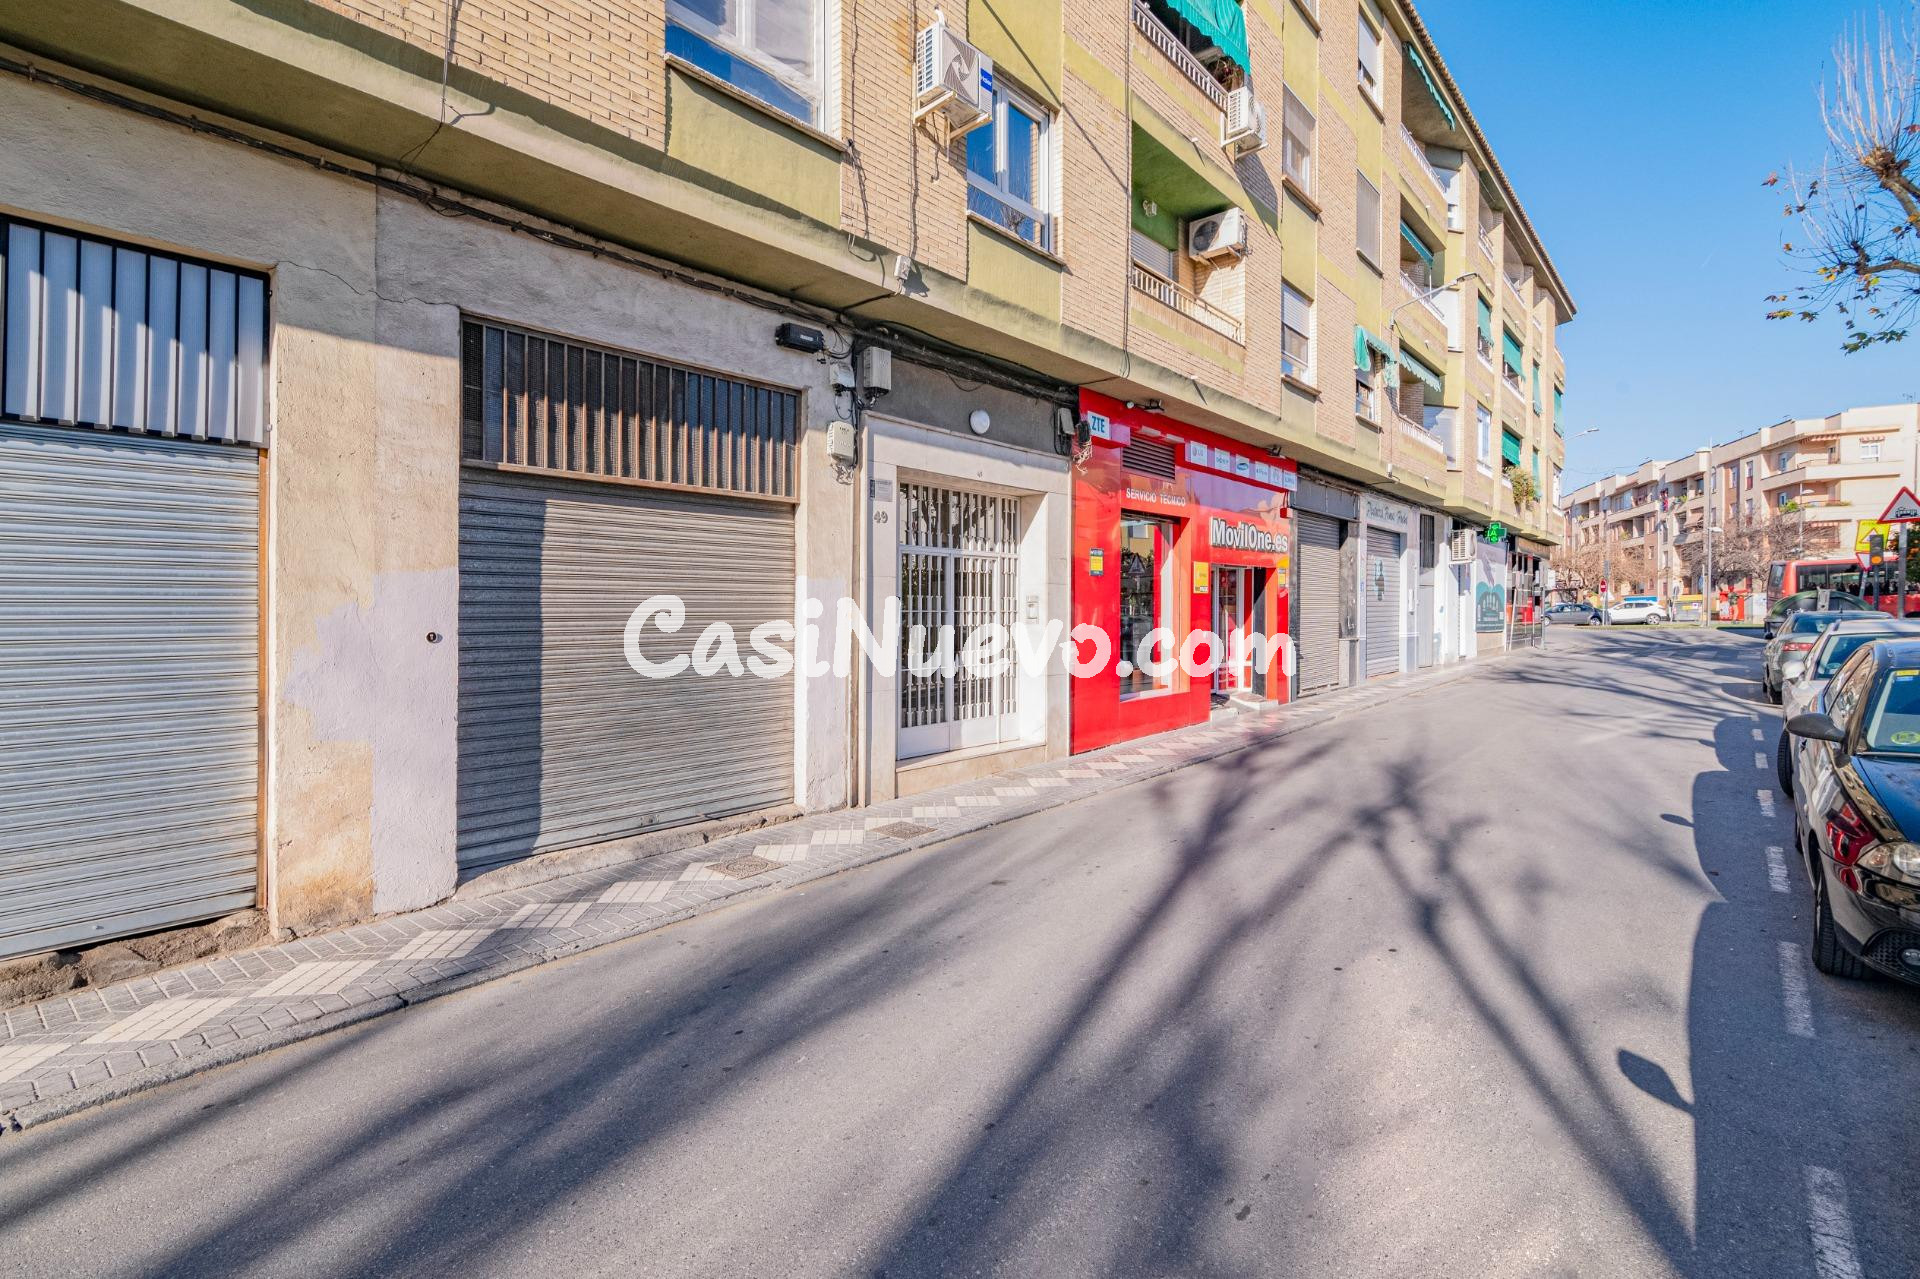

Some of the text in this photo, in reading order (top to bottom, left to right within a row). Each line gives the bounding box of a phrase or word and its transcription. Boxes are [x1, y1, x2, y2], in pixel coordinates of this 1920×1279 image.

[1091, 415, 1105, 433] ZTE
[1126, 487, 1157, 503] SERVICIO
[873, 510, 889, 524] 49
[1210, 516, 1289, 553] MovilOne.es
